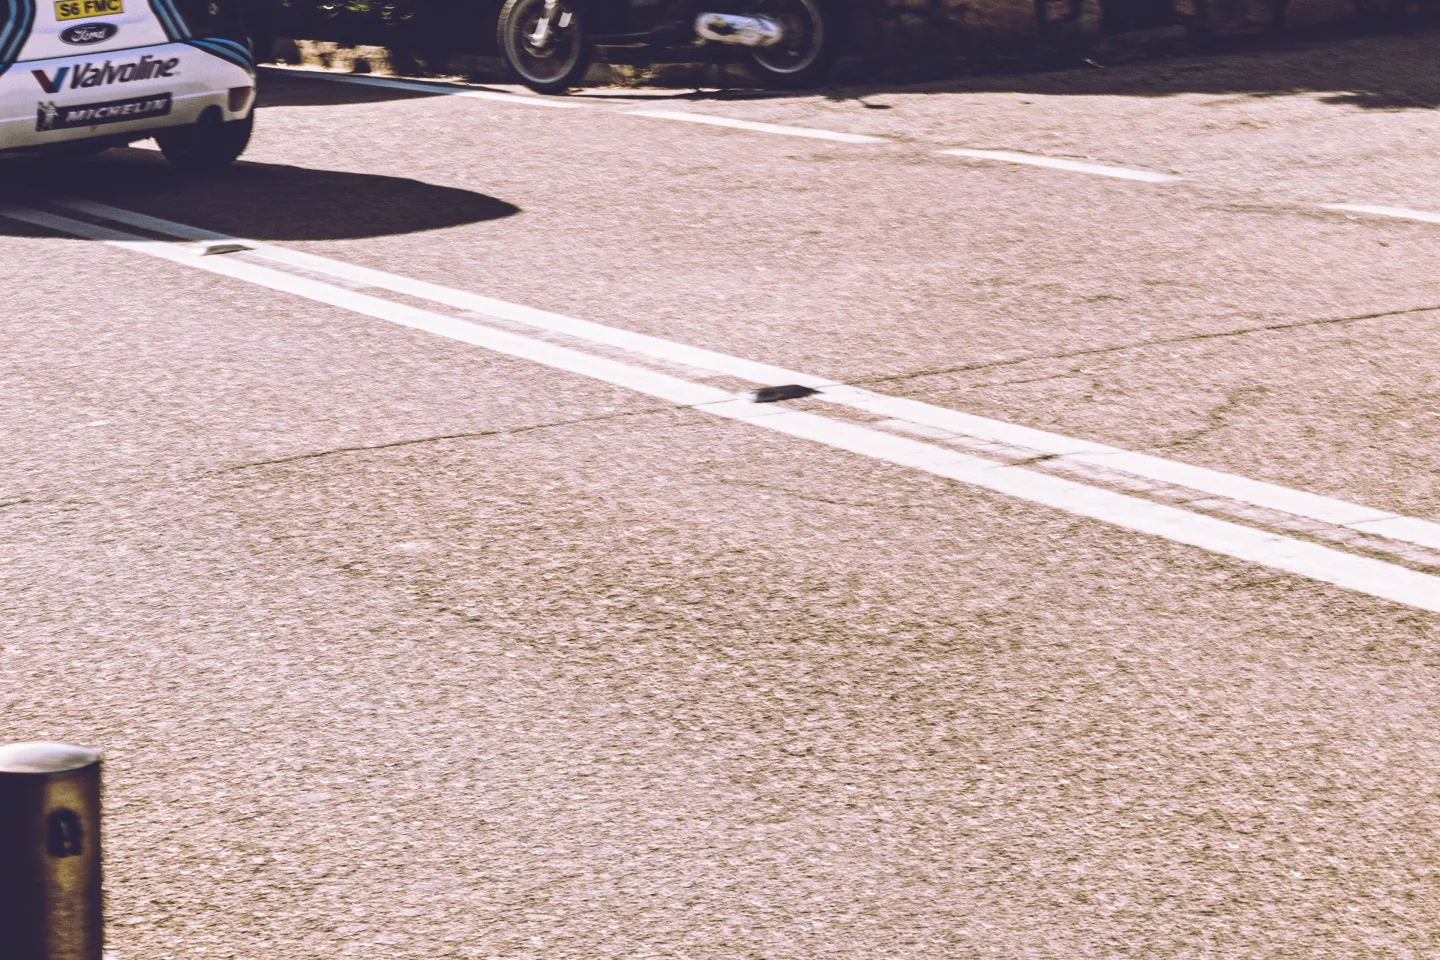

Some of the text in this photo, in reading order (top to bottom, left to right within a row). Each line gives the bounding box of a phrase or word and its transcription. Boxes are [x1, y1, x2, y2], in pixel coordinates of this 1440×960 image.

[60, 3, 80, 17] S6
[71, 26, 108, 42] Ford
[70, 55, 179, 89] Valvoline
[65, 98, 169, 122] MICHELIN
